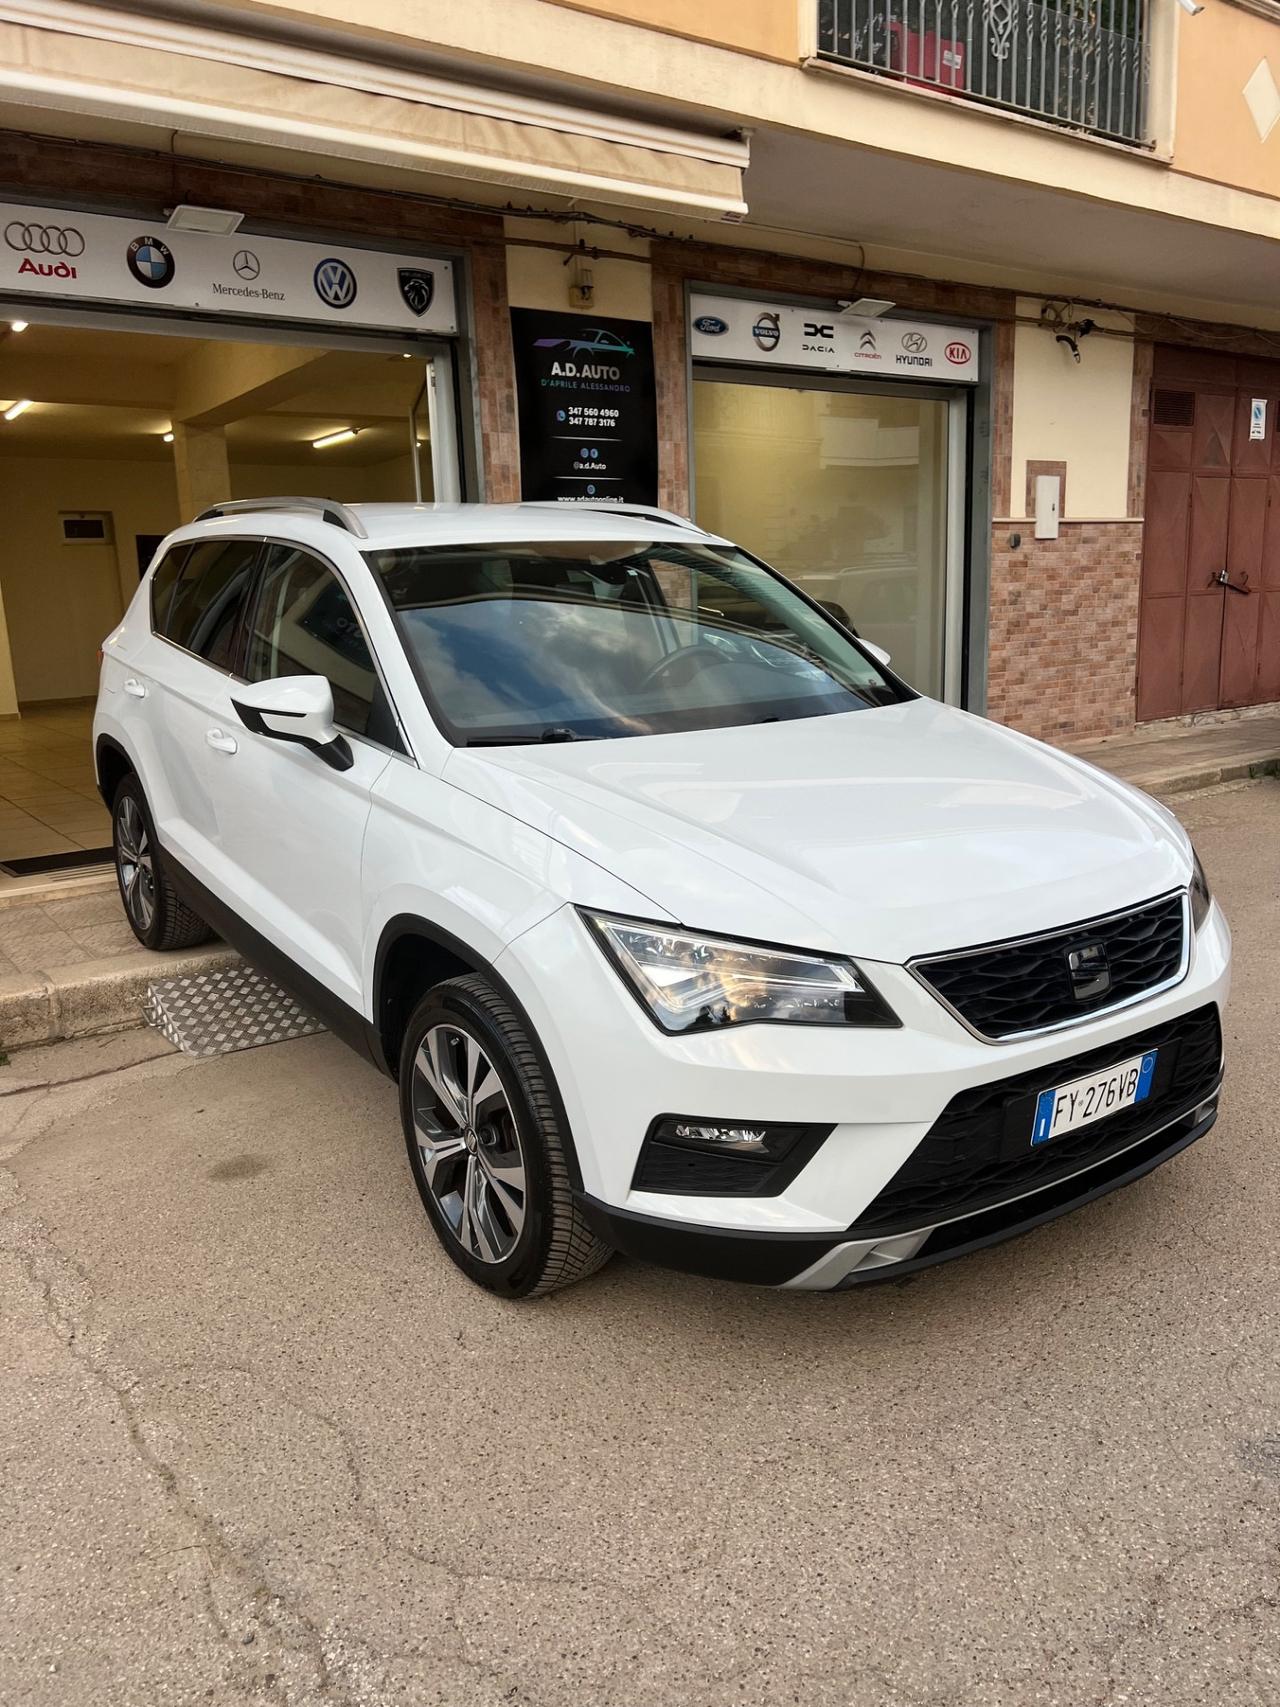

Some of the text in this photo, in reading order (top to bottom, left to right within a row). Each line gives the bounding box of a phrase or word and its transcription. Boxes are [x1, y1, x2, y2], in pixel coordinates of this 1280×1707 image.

[18, 258, 77, 279] Audi
[212, 283, 285, 301] Mercedes-Benz
[700, 319, 720, 333] Ford
[754, 328, 779, 337] VOLVO
[802, 344, 835, 353] DACIA
[949, 347, 967, 360] KIA
[896, 355, 933, 367] HYUNDAI
[580, 381, 631, 393] ALESSANDRO
[568, 407, 619, 417] 347 560 4960
[569, 417, 616, 427] 347 787 3176
